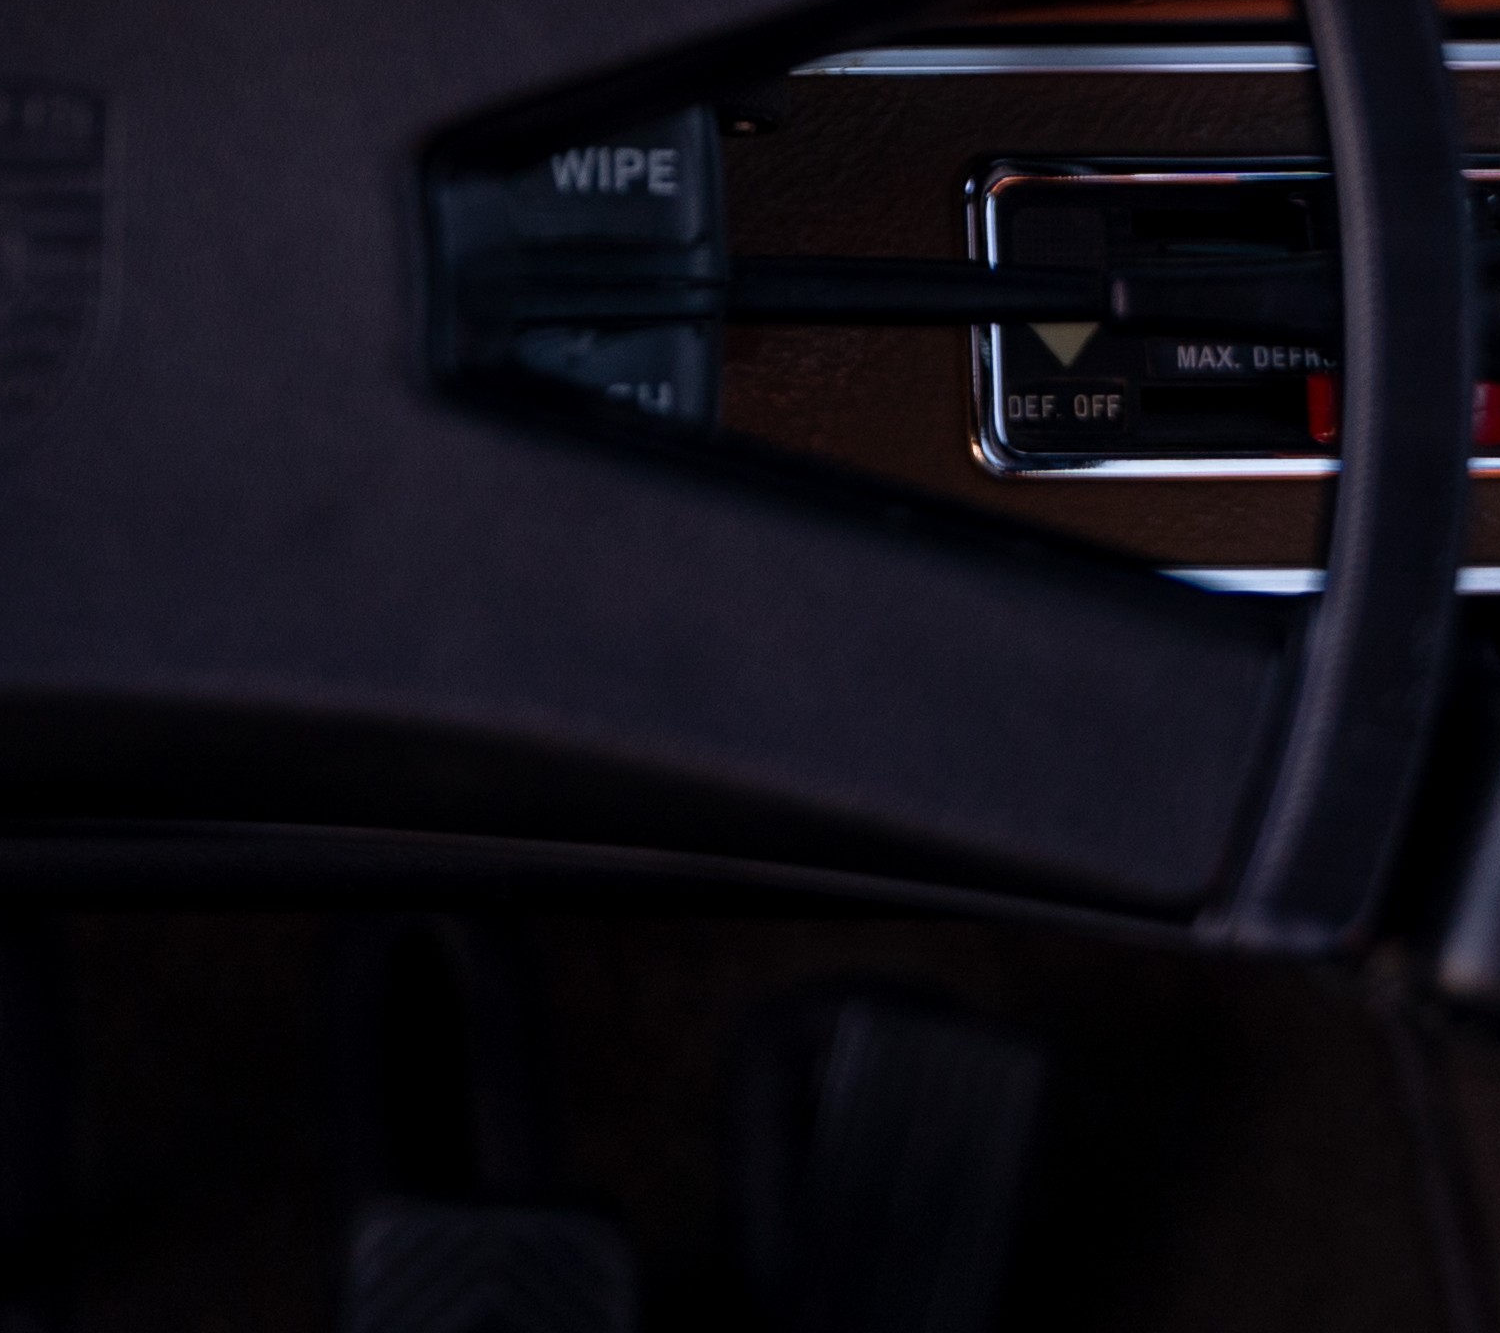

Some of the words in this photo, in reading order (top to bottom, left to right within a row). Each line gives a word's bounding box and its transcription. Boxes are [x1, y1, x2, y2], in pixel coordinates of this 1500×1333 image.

[550, 145, 680, 197] WIPE
[1176, 344, 1241, 370] MAX.
[1073, 393, 1123, 420] OFF
